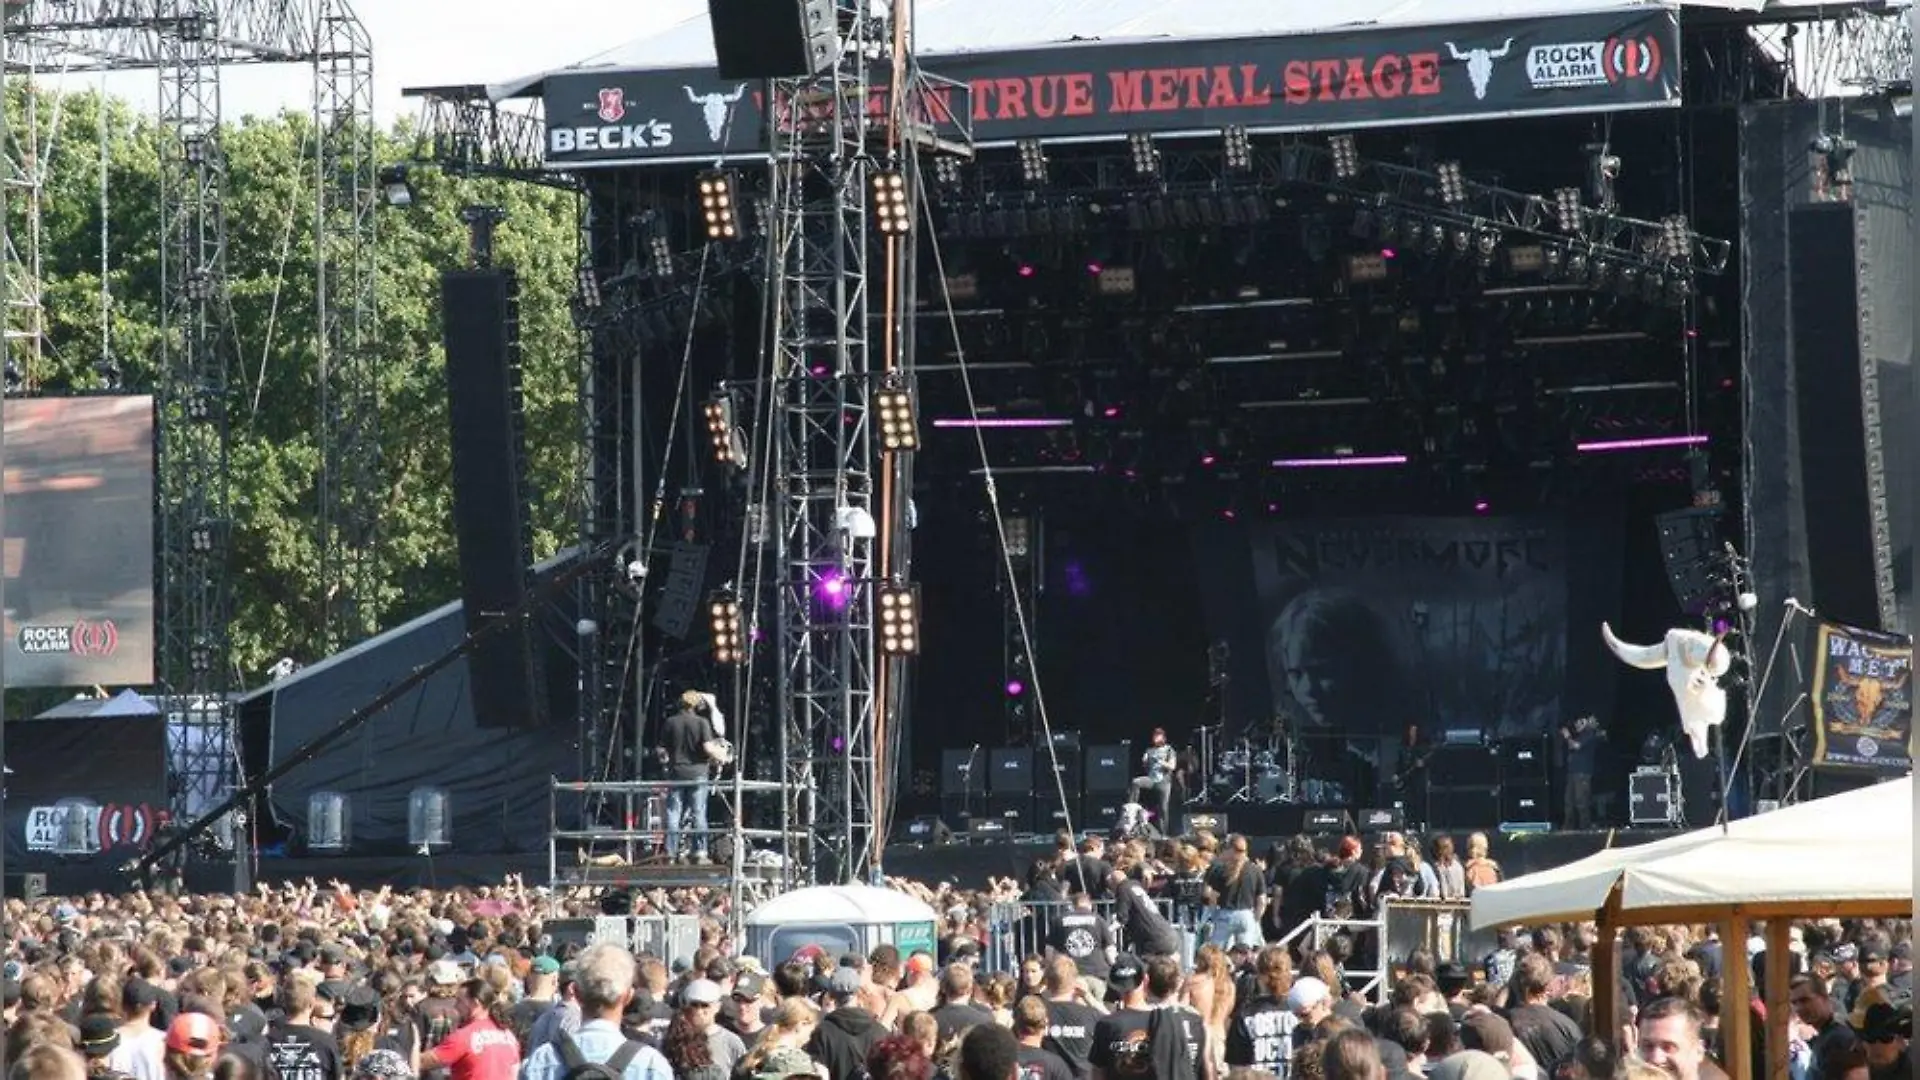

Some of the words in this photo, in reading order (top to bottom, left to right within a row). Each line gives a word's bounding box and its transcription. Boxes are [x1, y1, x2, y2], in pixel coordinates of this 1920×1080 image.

[1535, 46, 1595, 64] ROCK
[1535, 63, 1597, 80] ALARM
[971, 72, 1095, 121] TRUE
[1108, 63, 1270, 113] METAL
[1284, 53, 1440, 103] STAGE
[551, 119, 673, 152] BECK'S
[24, 628, 69, 641] ROCK
[24, 640, 70, 652] ALARM
